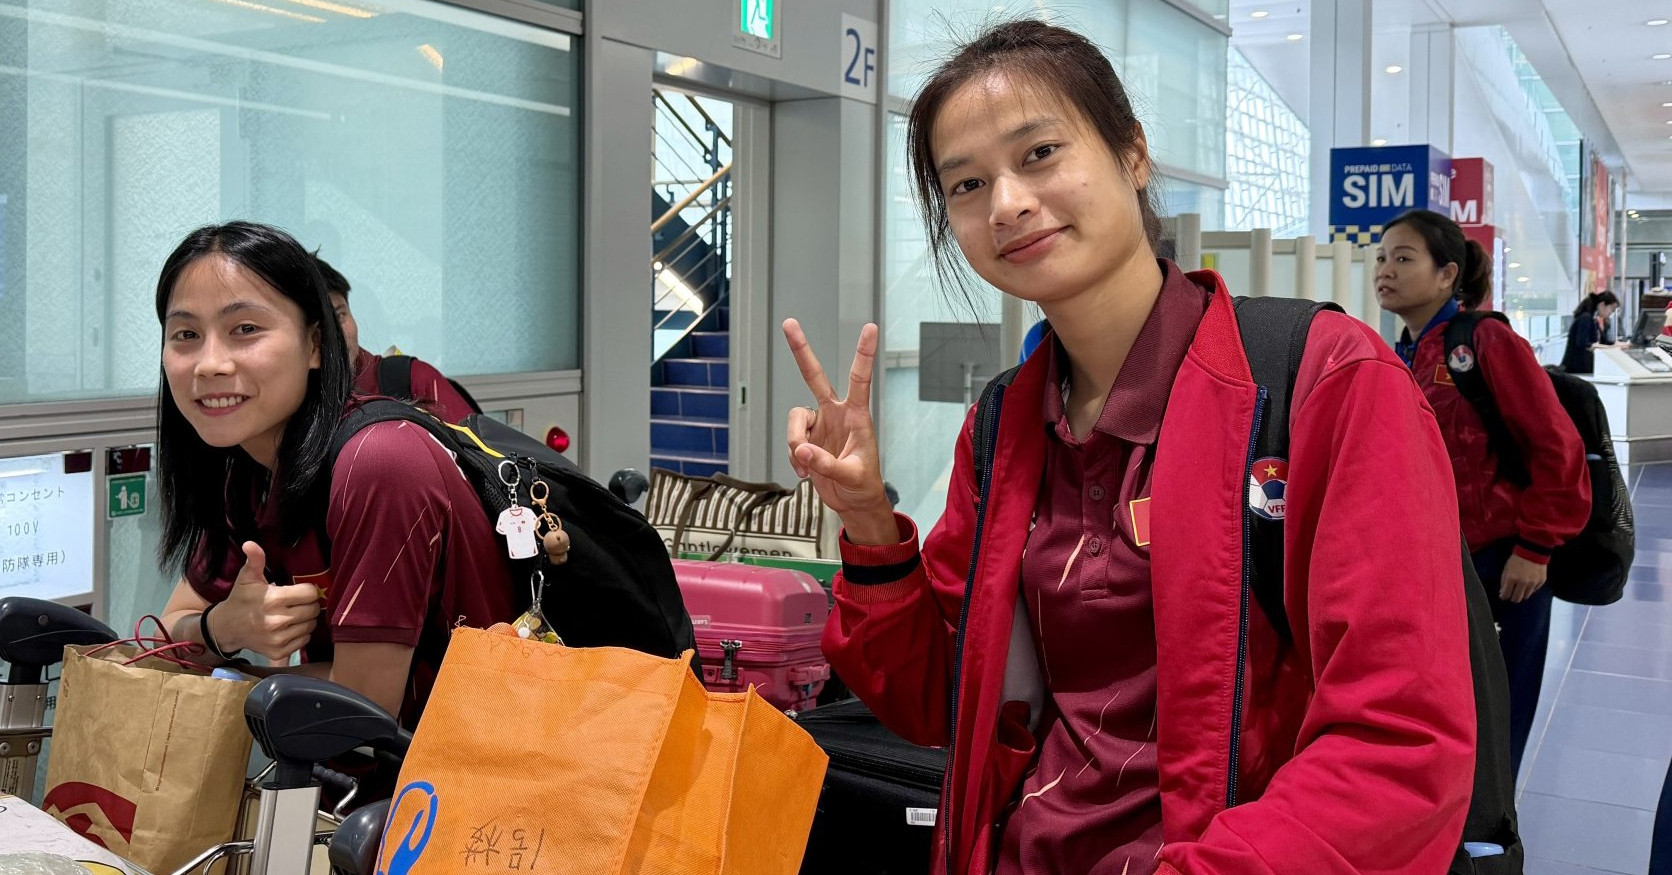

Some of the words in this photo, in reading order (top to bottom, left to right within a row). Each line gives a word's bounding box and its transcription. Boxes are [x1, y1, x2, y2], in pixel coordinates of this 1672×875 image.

[844, 27, 875, 87] 2F
[1344, 163, 1378, 174] PREPAID
[1391, 162, 1412, 172] DATA
[1342, 172, 1415, 208] SIM
[1267, 504, 1286, 514] VFF
[7, 520, 39, 537] 100V
